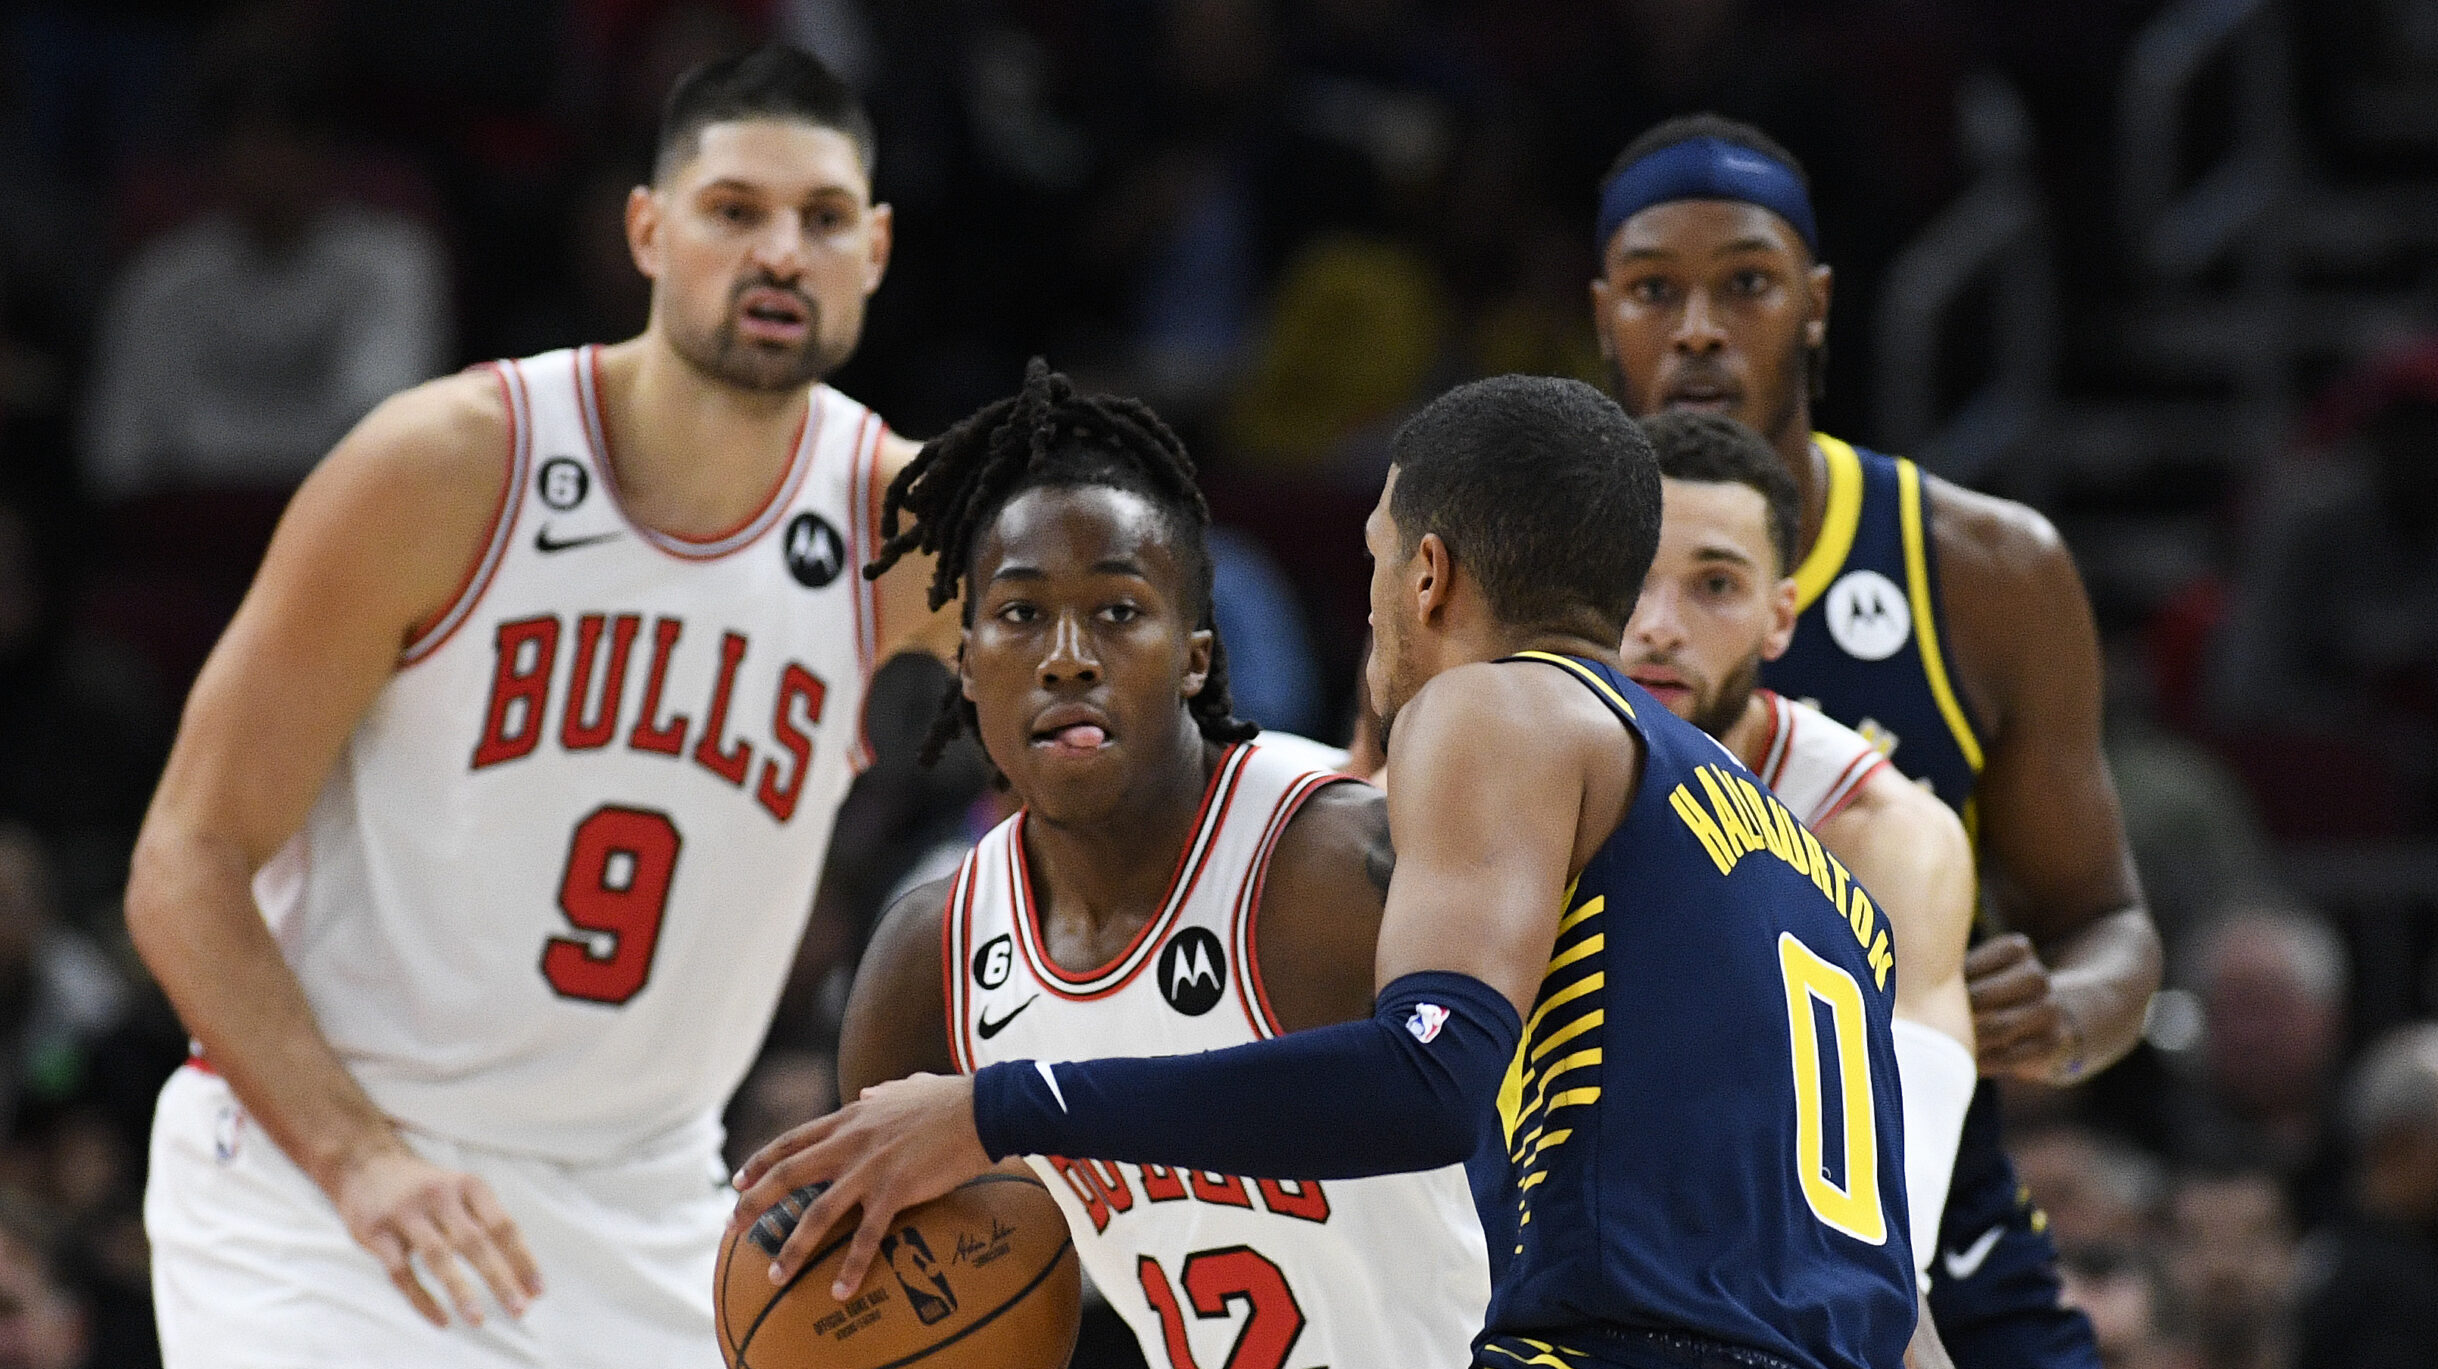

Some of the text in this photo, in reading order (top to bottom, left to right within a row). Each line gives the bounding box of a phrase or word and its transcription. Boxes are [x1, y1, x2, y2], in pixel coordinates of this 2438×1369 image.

[470, 613, 827, 824] BULLS
[540, 804, 683, 1005] 9
[982, 938, 1012, 987] 6
[1777, 930, 1888, 1246] 0
[1136, 1244, 1329, 1369] 12
